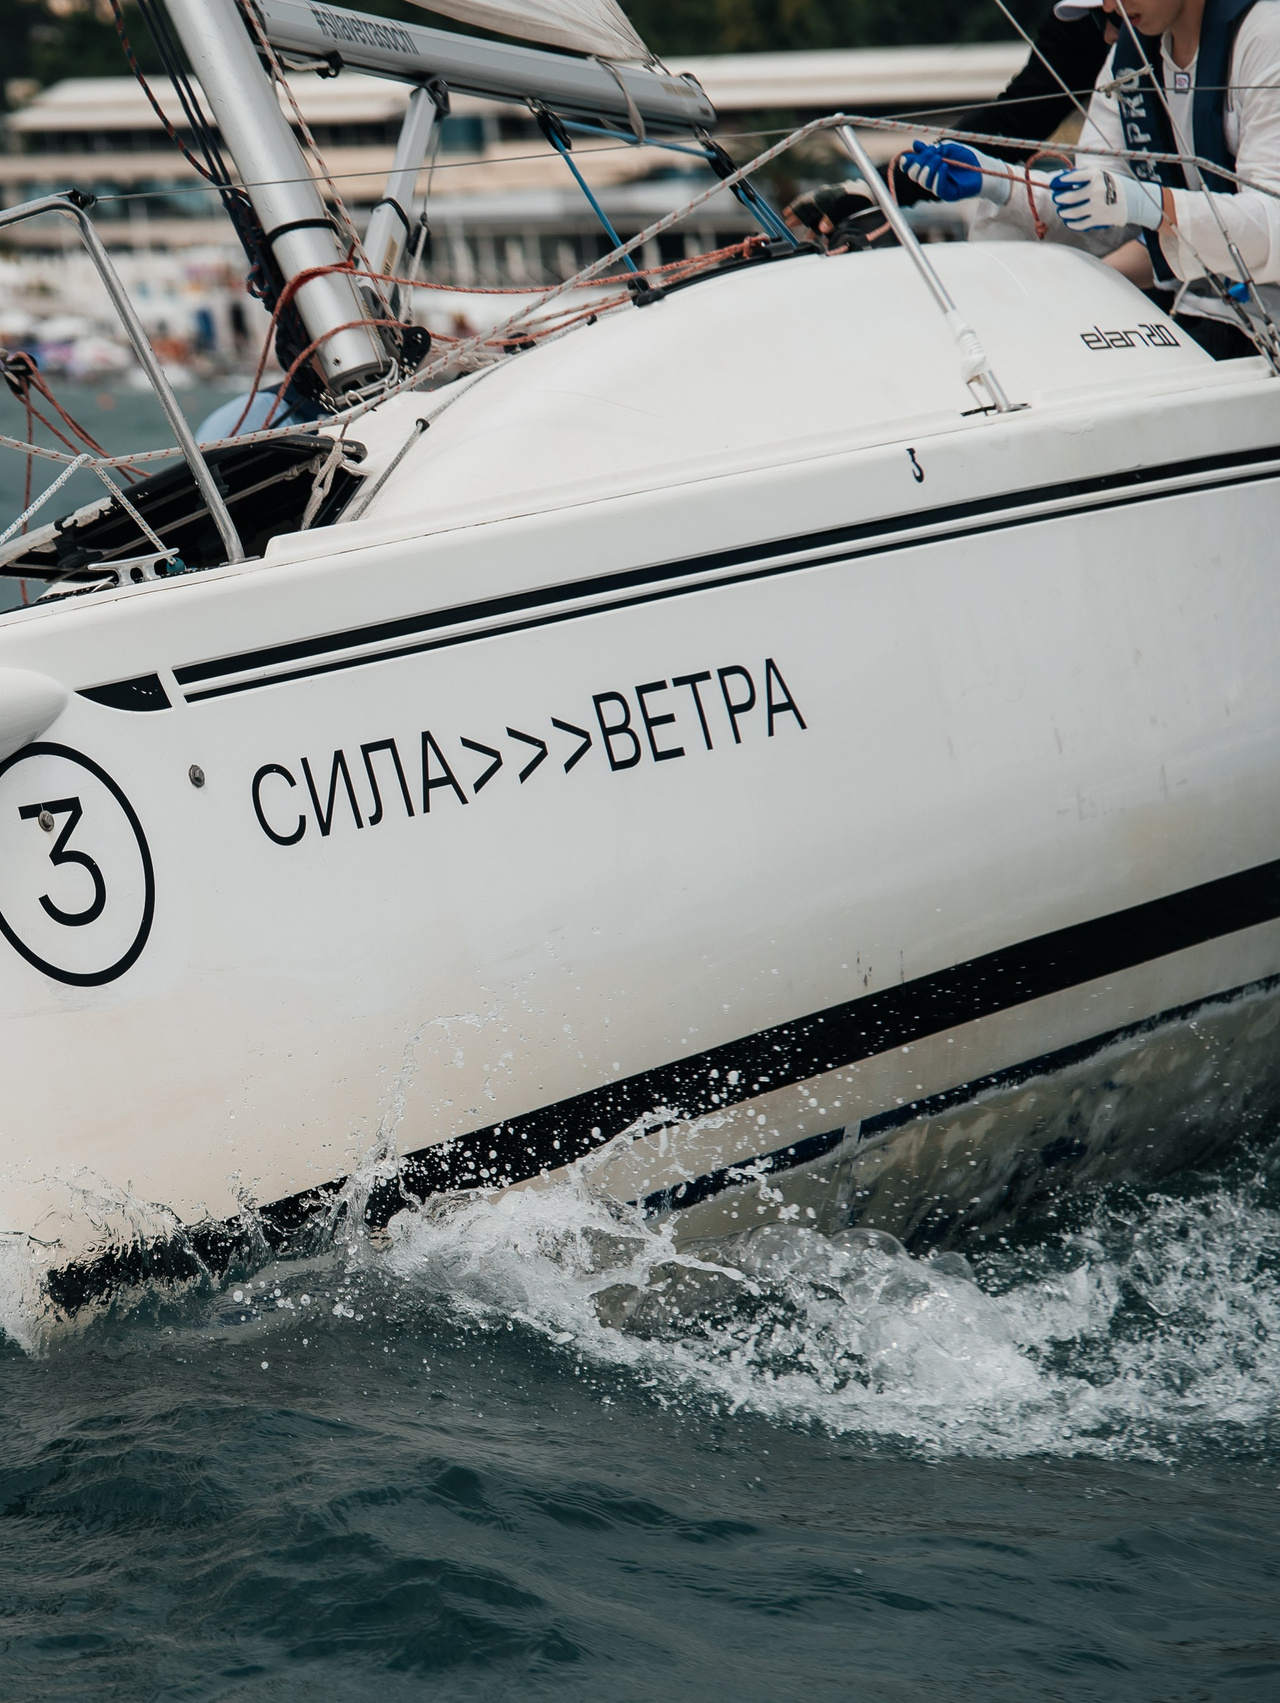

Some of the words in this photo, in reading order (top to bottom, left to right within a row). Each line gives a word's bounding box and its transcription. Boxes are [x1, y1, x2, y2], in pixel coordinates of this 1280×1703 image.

[1080, 324, 1150, 350] elan
[250, 729, 469, 846] СИЛА
[591, 657, 808, 772] ВЕТРА
[17, 795, 107, 928] 3
